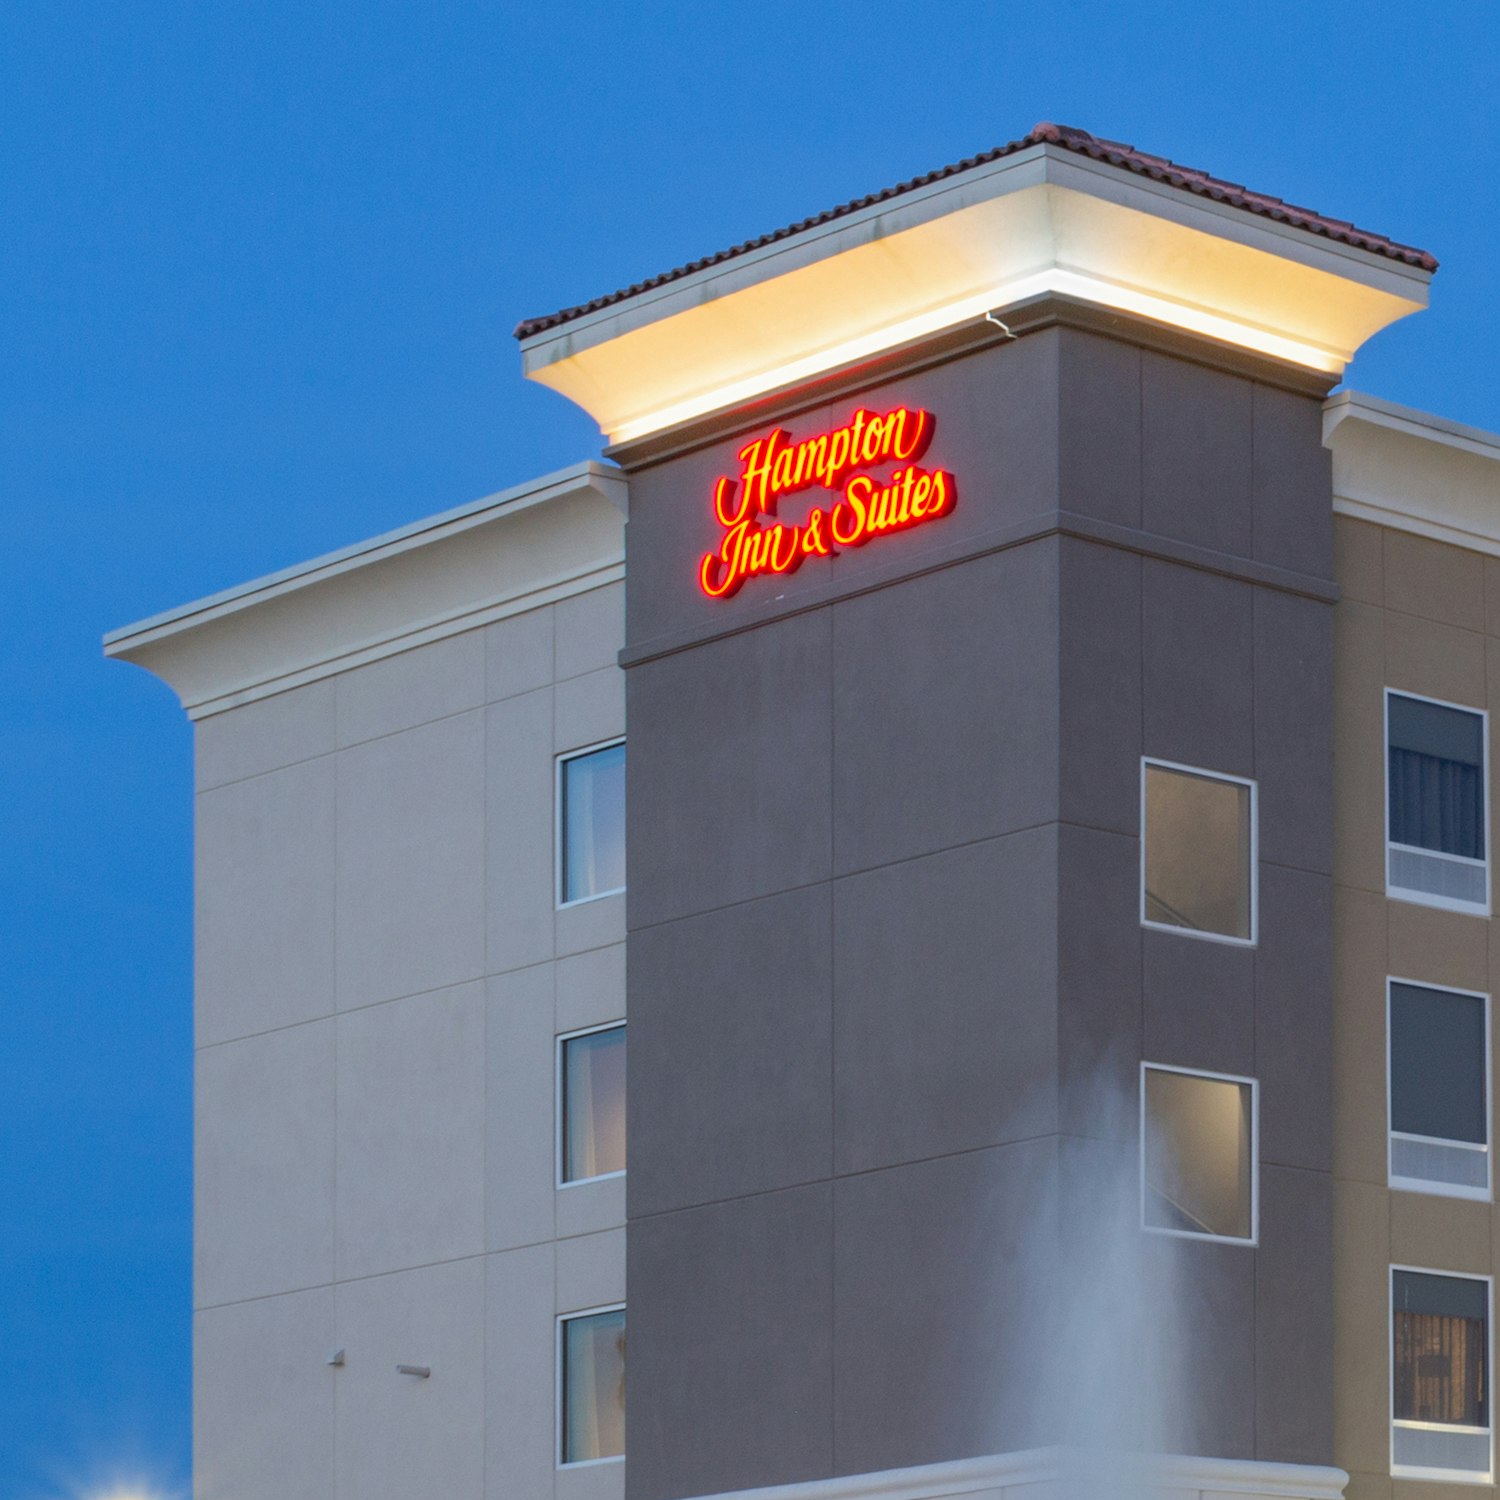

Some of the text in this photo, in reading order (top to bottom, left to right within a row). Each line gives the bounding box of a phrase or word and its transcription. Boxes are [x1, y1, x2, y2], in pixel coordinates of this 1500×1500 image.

[715, 407, 934, 527] Hampton
[701, 464, 957, 597] Inn & Suites
